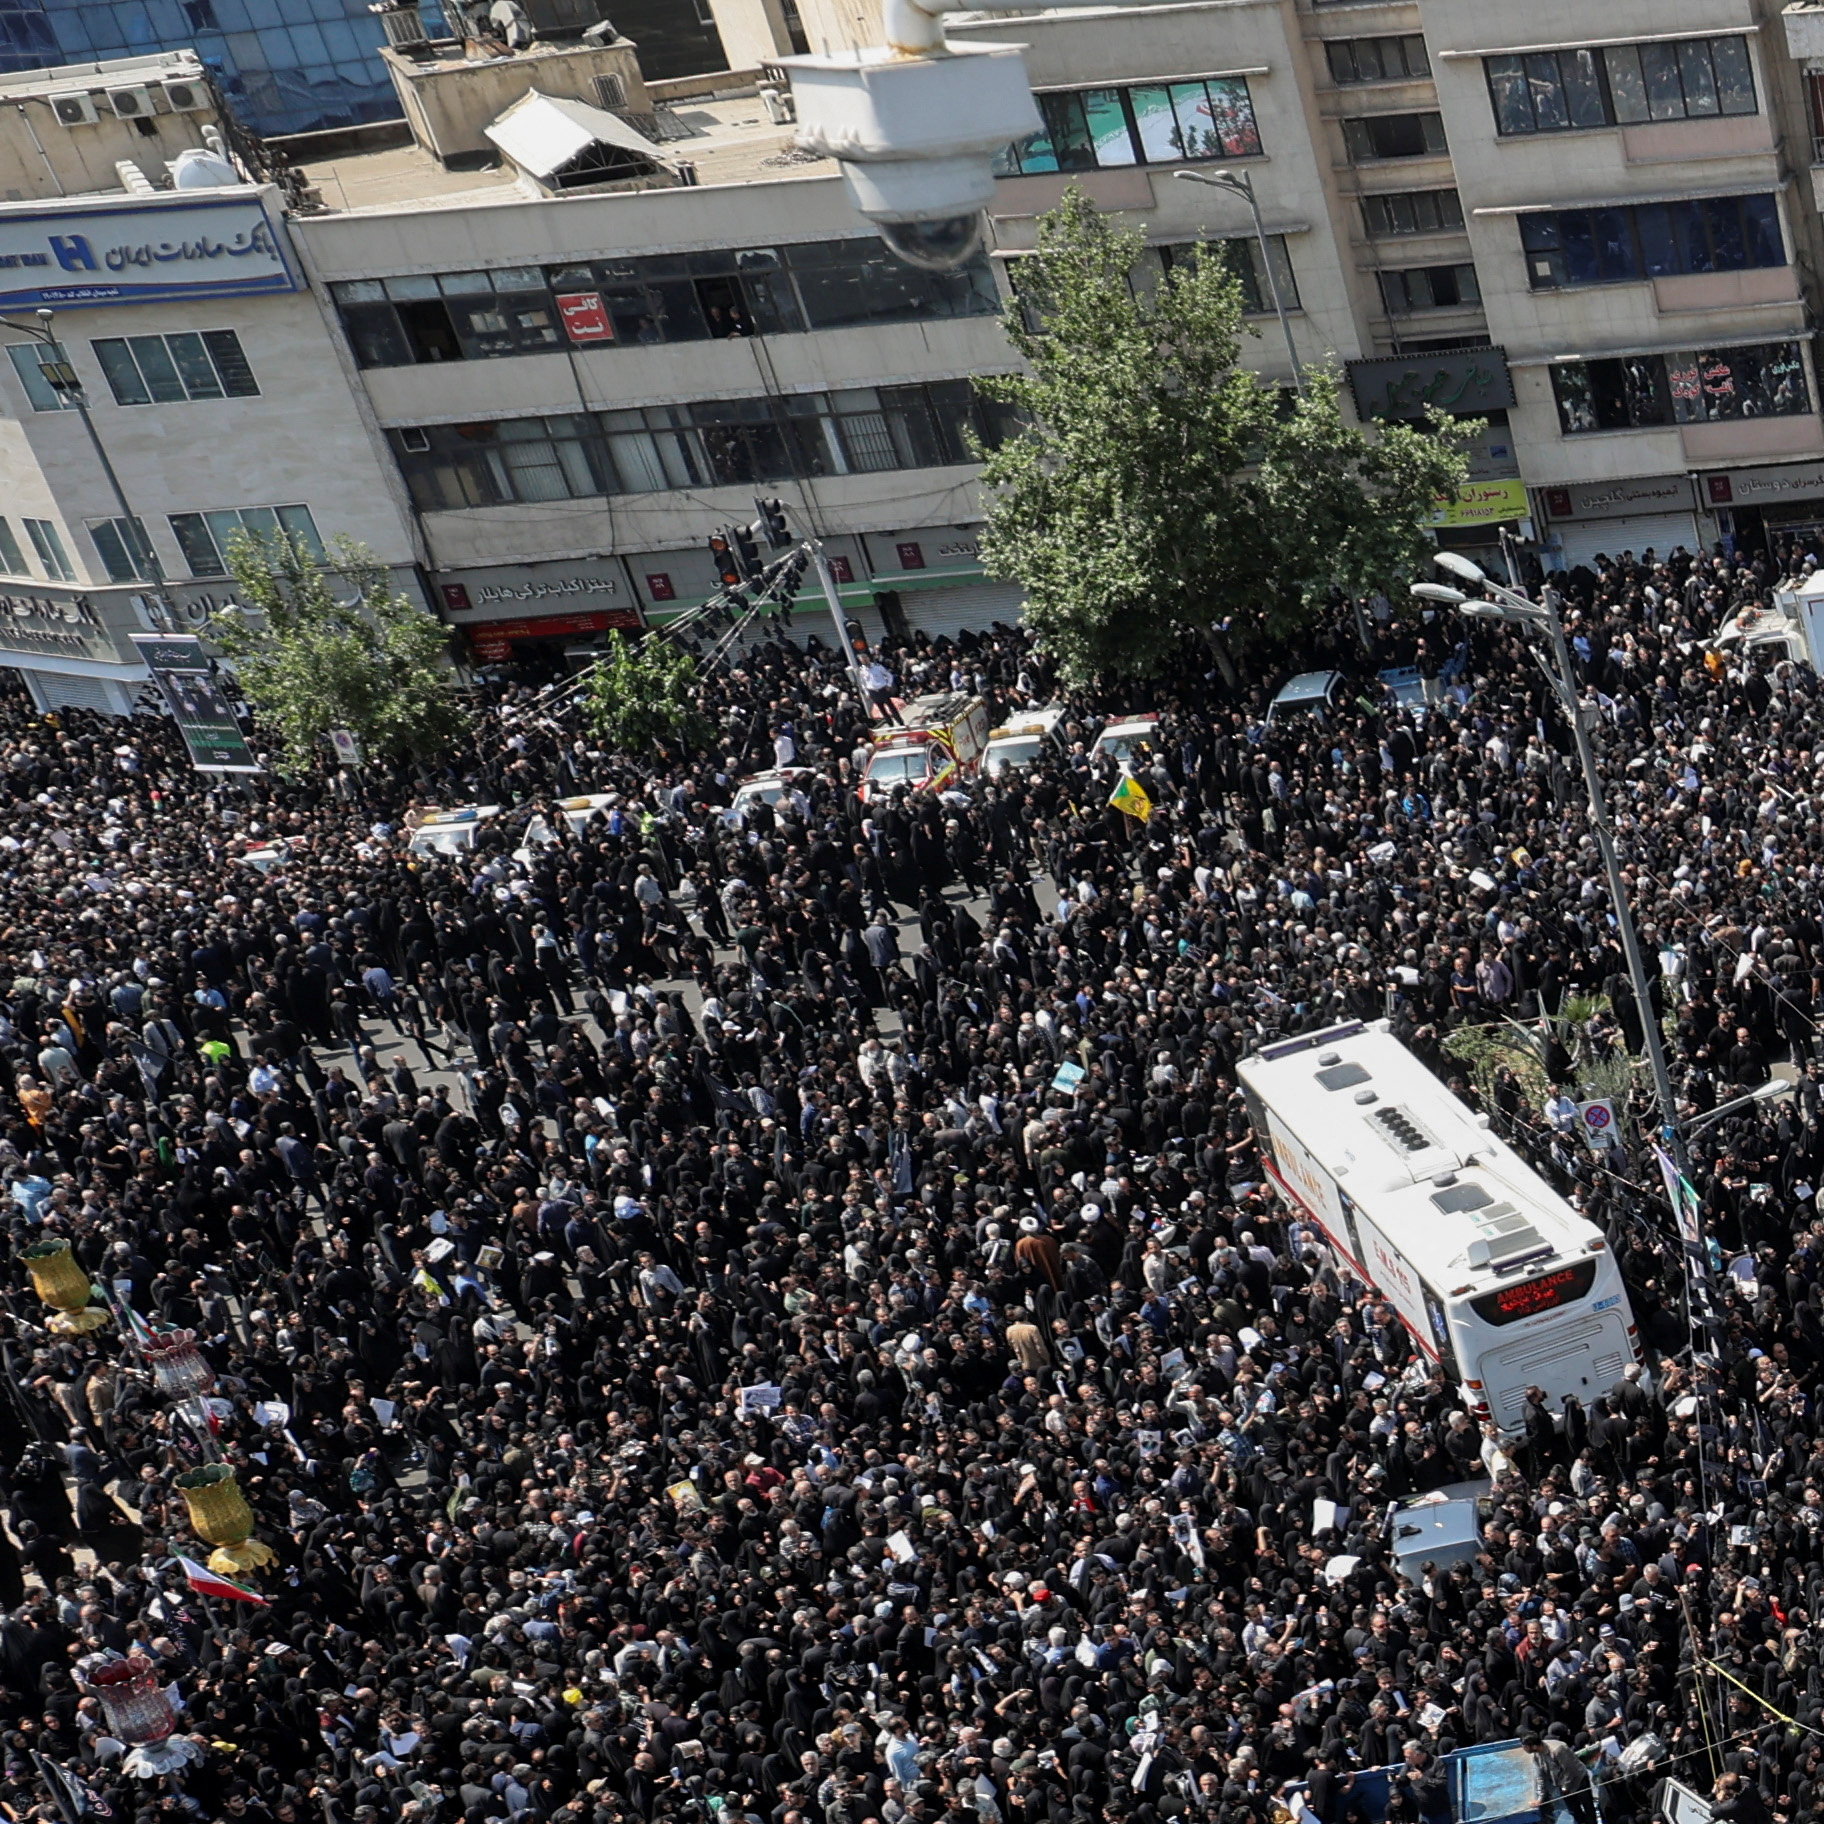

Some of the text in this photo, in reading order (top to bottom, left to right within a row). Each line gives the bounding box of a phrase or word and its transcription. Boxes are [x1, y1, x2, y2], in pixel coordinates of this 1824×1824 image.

[105, 220, 279, 272] بانک صادرات ایران
[563, 297, 598, 316] کافی
[571, 316, 604, 335] نت
[1495, 1268, 1575, 1303] AMBULANCE
